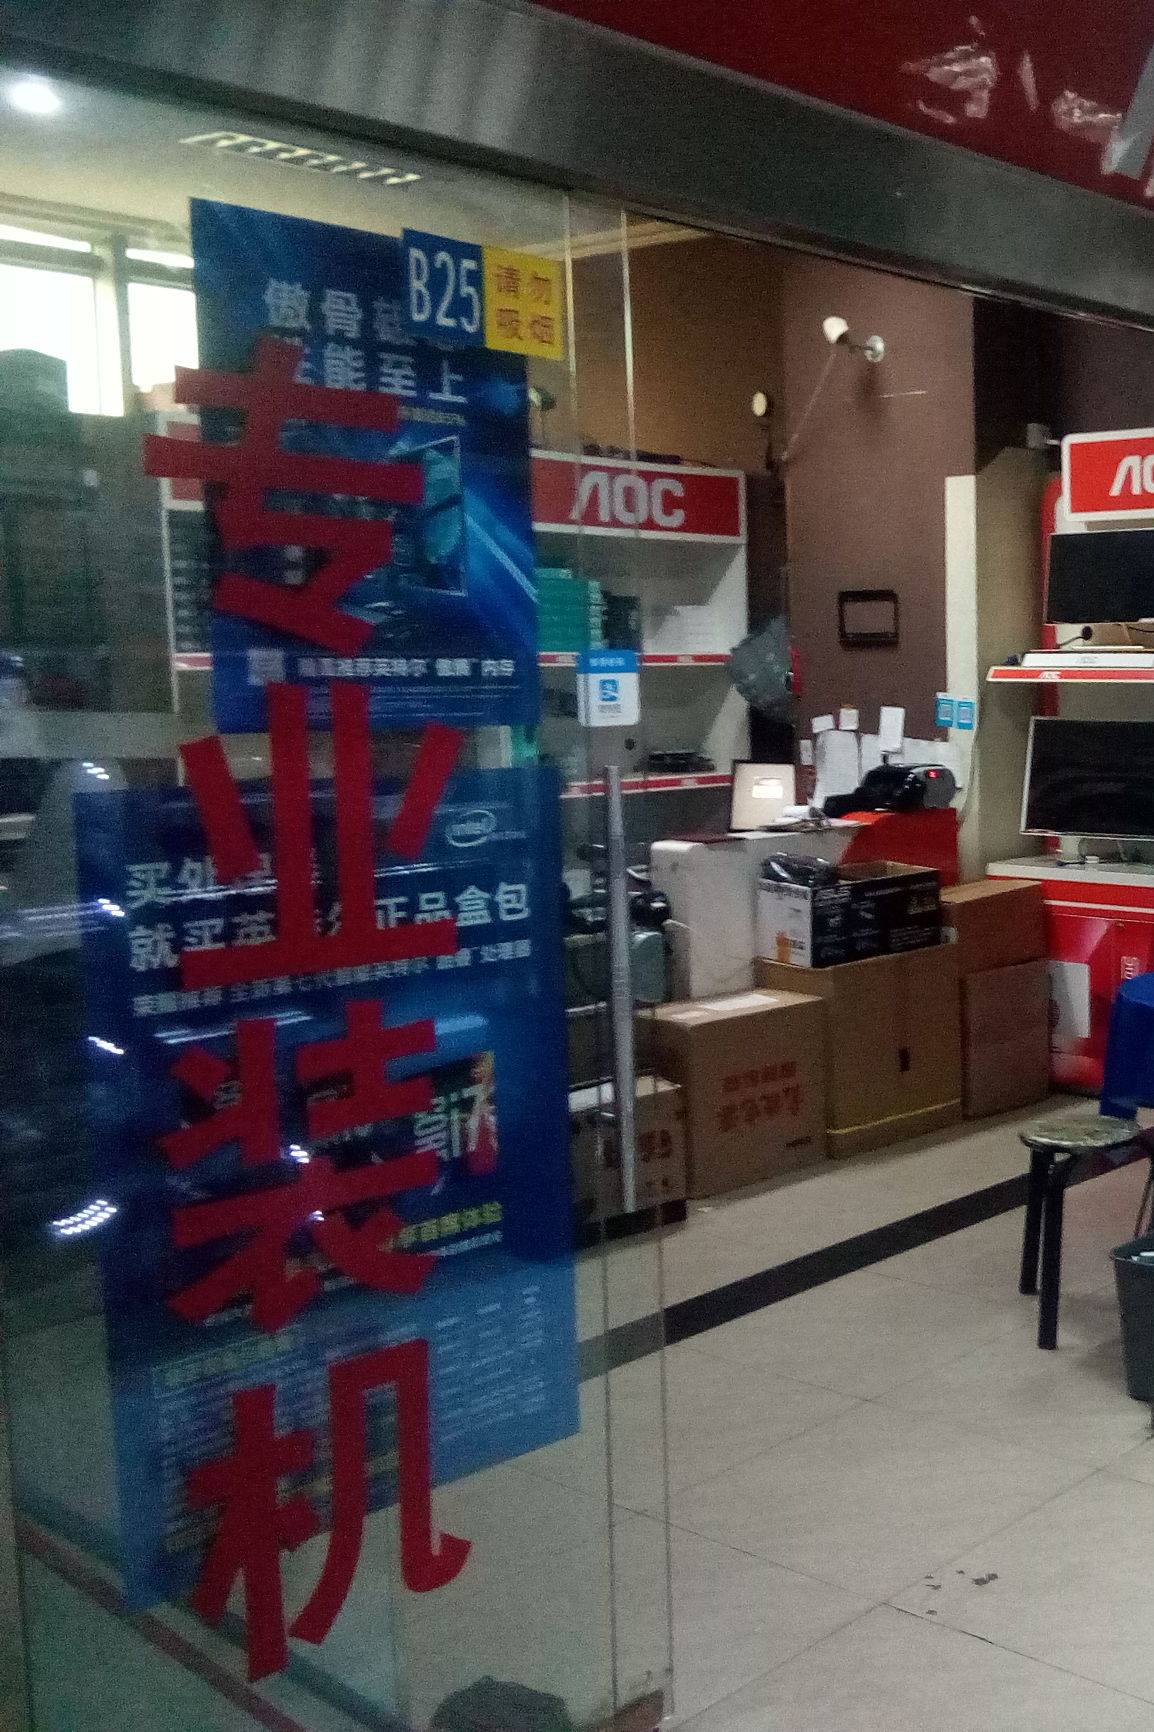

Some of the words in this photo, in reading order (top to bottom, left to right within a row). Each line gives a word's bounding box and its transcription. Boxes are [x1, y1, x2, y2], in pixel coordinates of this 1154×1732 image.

[408, 247, 482, 334] B25
[495, 264, 551, 305] 请勿
[569, 470, 686, 528] AOC
[142, 333, 472, 1684] 专业装机
